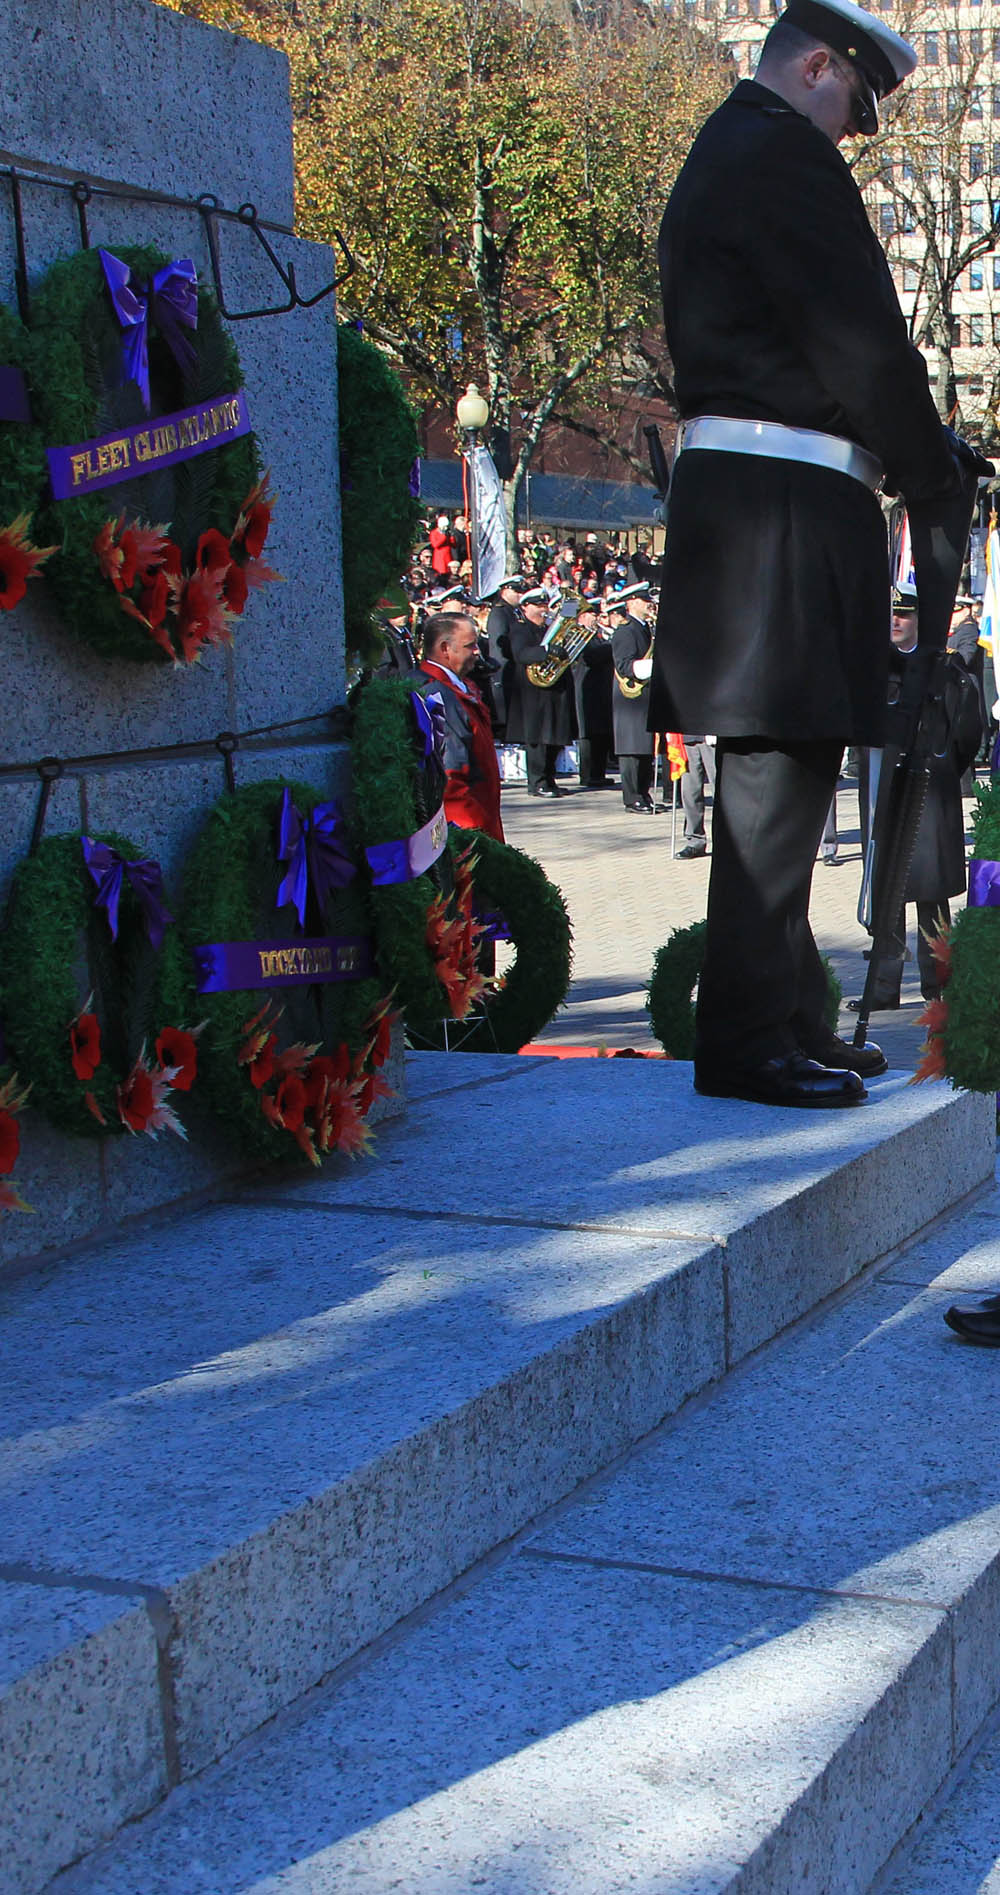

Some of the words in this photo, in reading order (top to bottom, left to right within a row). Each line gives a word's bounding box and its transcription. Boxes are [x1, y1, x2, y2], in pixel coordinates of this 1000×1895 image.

[70, 437, 131, 486] FLEET
[134, 423, 178, 462] CLUB
[178, 398, 242, 450] ATLANTIC
